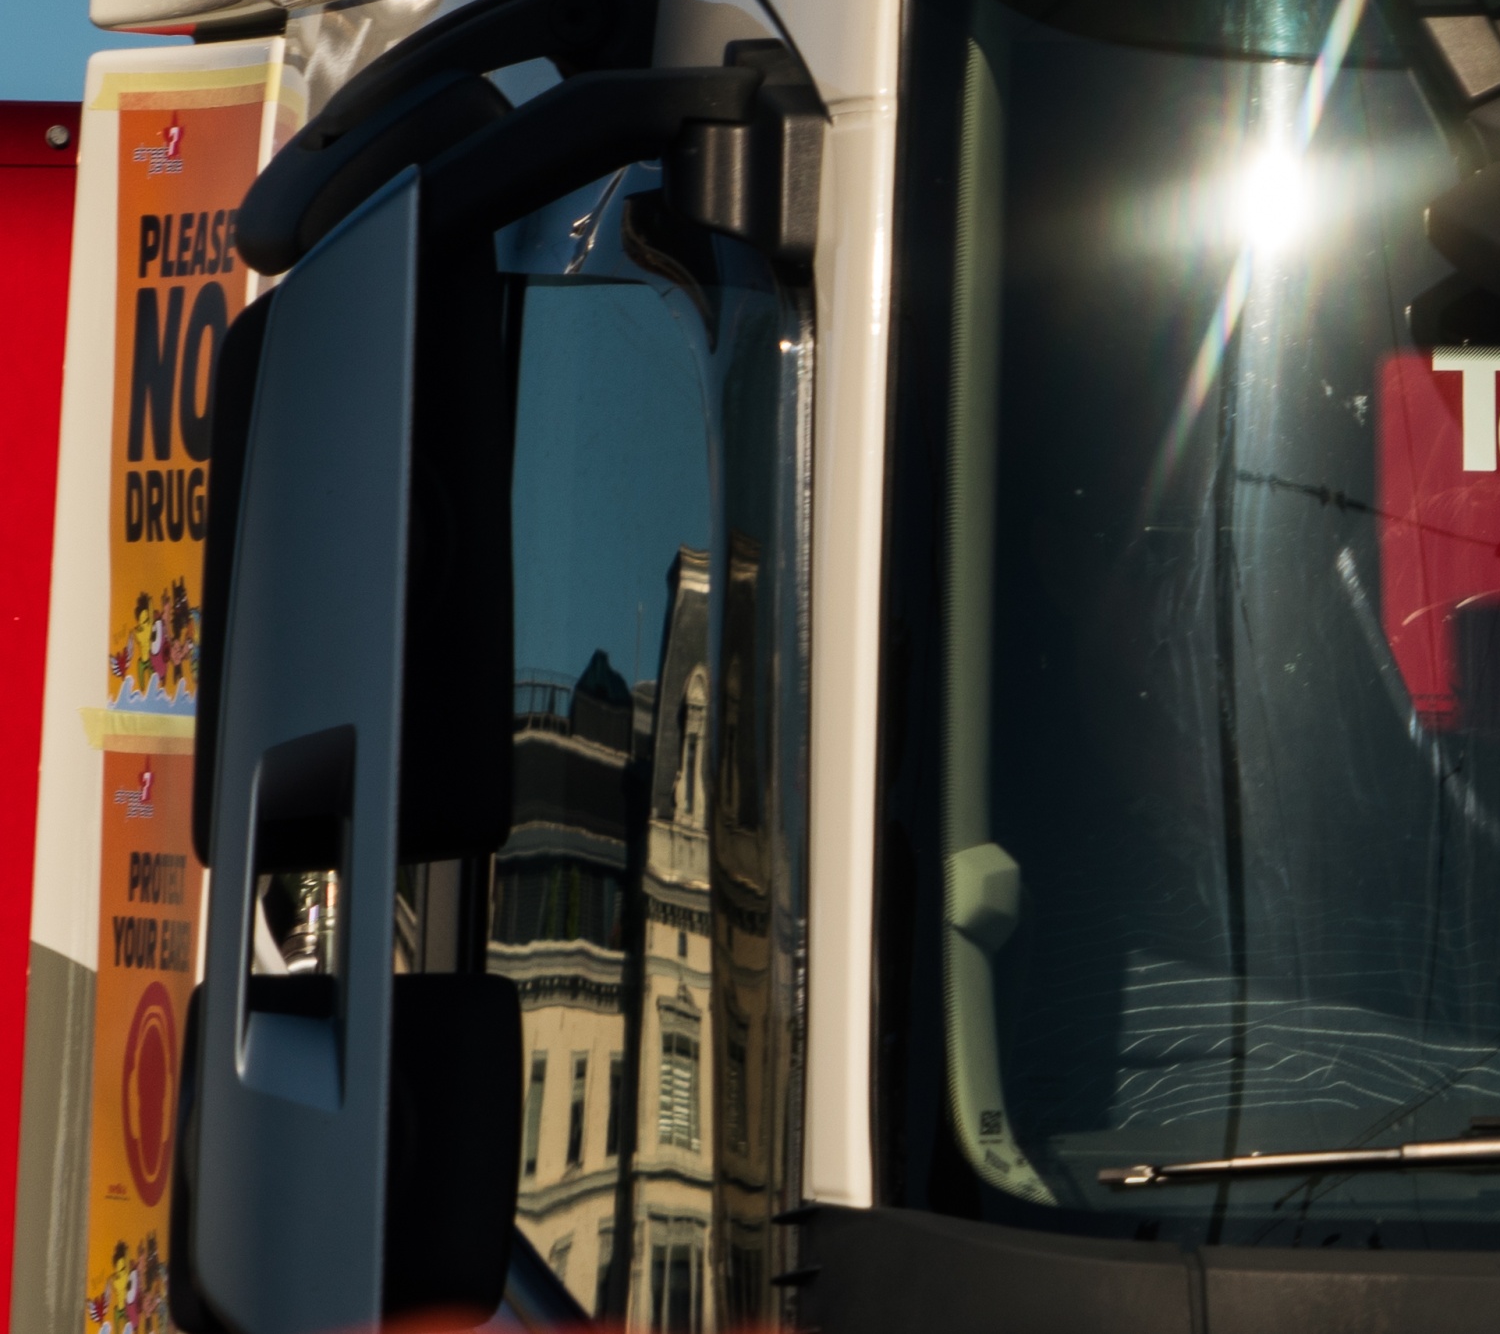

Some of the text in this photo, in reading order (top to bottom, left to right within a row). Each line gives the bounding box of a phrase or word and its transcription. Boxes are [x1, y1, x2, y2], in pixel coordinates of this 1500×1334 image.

[138, 208, 240, 279] PLEASE
[127, 281, 230, 463] NO
[126, 467, 208, 544] DRUG
[112, 915, 157, 970] YOUR
